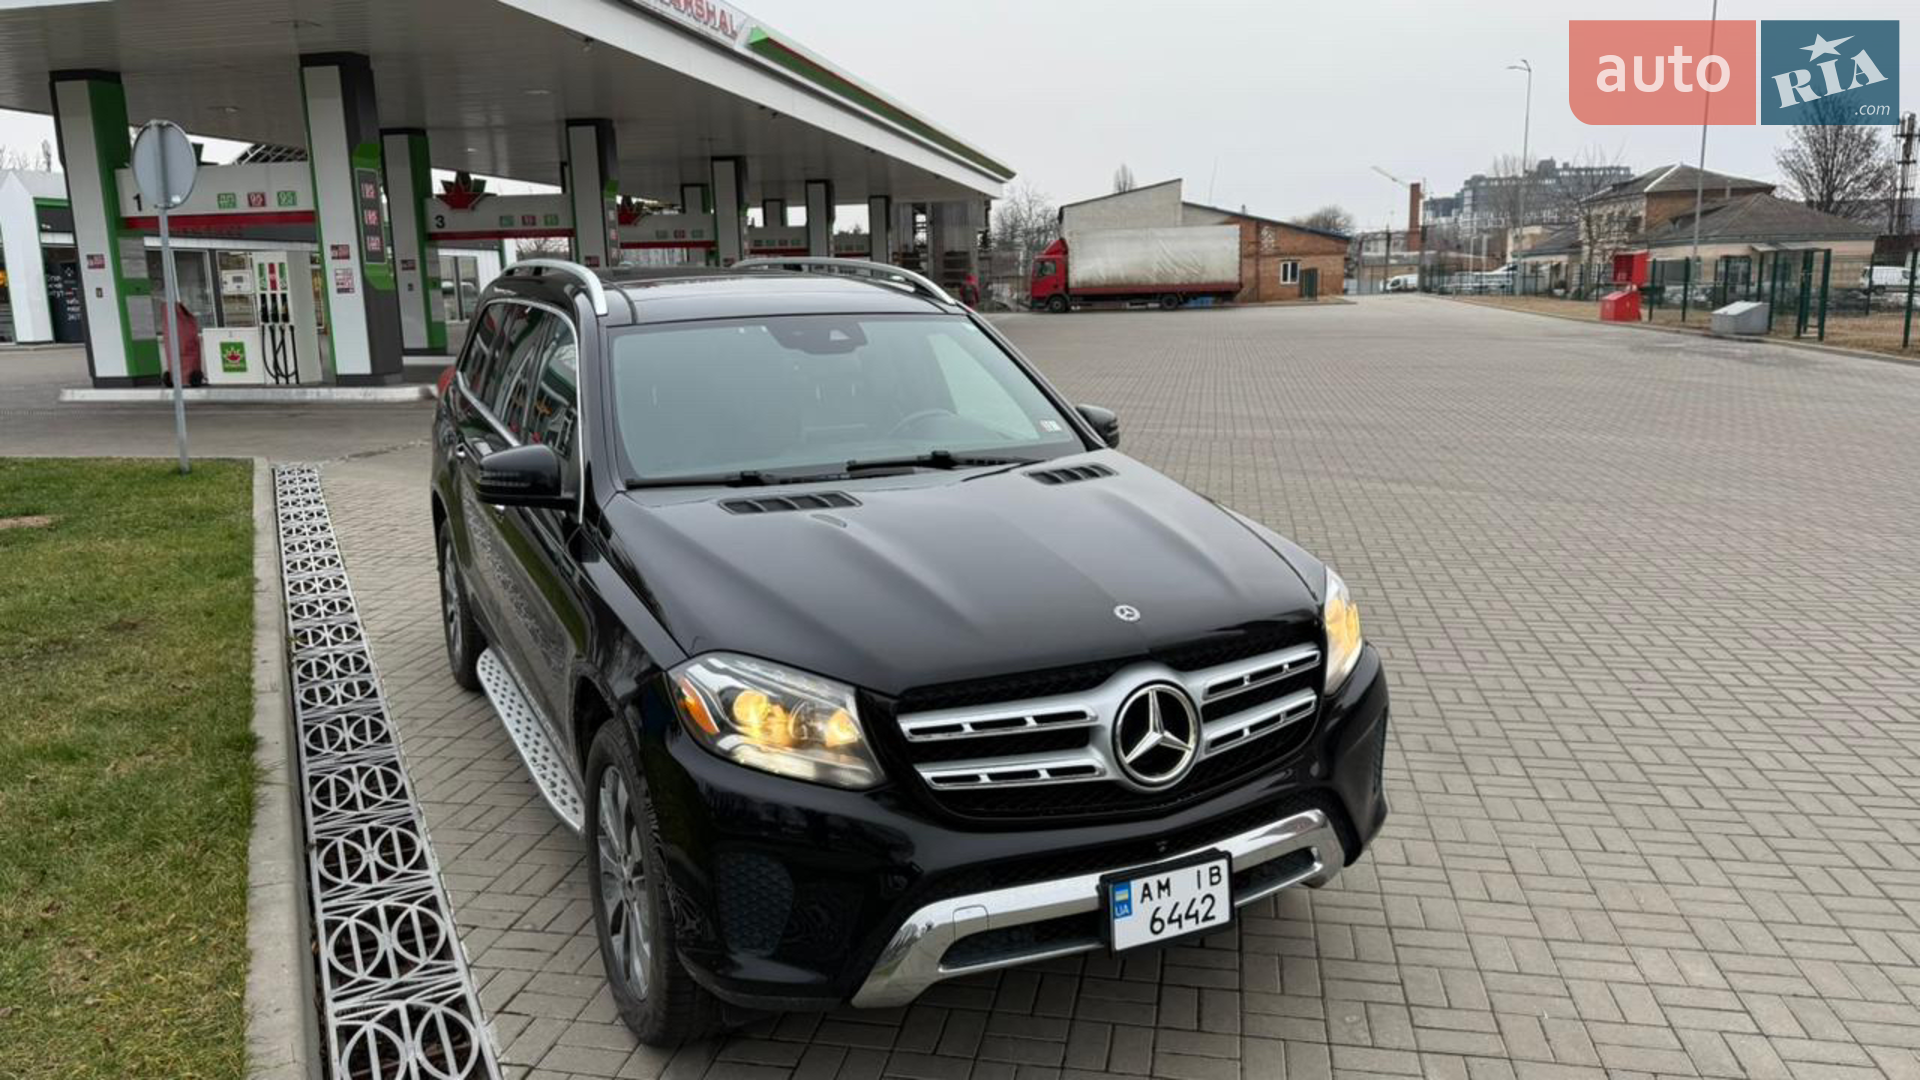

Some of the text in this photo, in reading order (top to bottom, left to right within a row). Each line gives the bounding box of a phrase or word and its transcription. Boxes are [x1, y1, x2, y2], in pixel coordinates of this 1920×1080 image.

[133, 193, 142, 212] 1
[434, 215, 446, 229] 3
[1140, 865, 1222, 904] AM IB
[1115, 903, 1129, 917] UA
[1149, 893, 1216, 935] 6442
